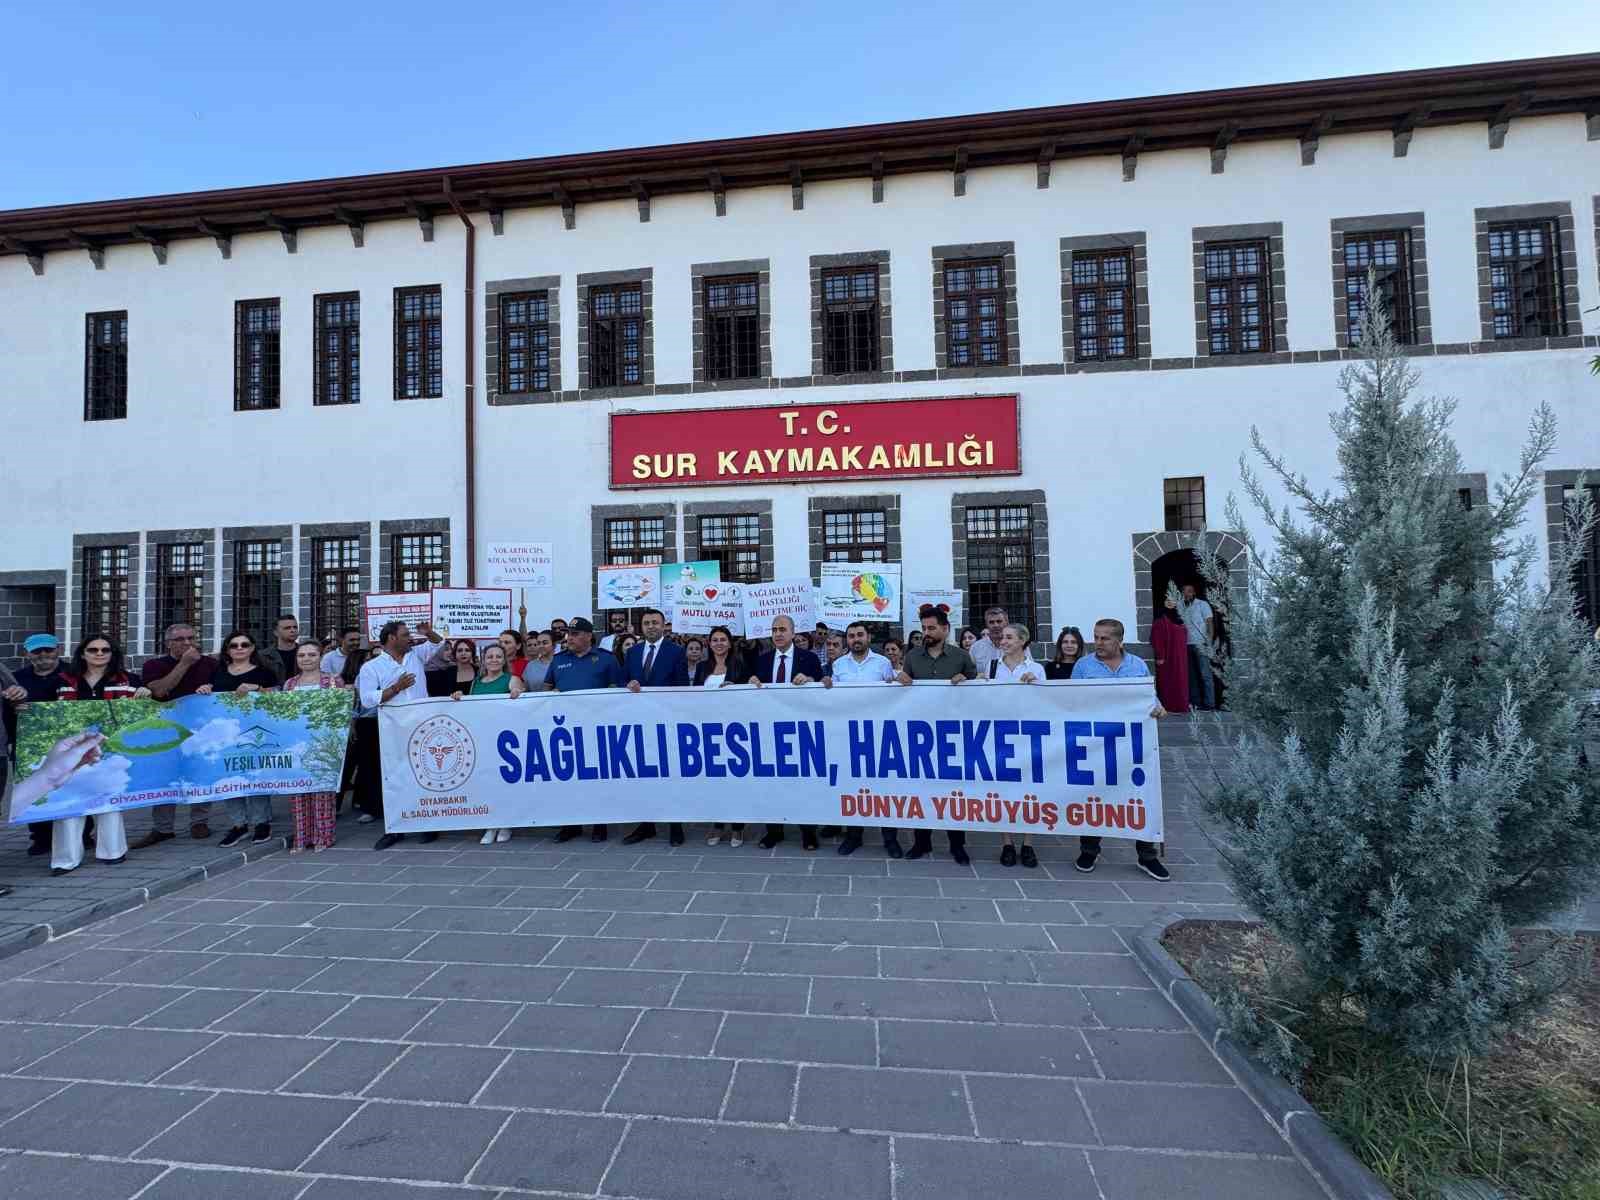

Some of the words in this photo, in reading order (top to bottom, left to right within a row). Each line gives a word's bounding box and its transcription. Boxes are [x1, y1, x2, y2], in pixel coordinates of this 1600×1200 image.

[632, 453, 698, 479] SUR
[718, 434, 994, 475] KAYMAKAMLIĞI
[681, 609, 711, 618] MUTLU
[713, 610, 736, 620] YAŞA
[258, 754, 293, 769] VATAN
[496, 714, 670, 785] SAĞLIKLI
[676, 720, 838, 787] BESLEN,
[848, 719, 1051, 784] HAREKET
[1063, 720, 1146, 787] ET!
[214, 780, 251, 793] EĞİTİM
[253, 775, 313, 790] MÜDÜRLÜĞÜ
[840, 787, 925, 820] DÜNYA
[931, 790, 1059, 831] YÜRÜYÜŞ
[1066, 796, 1147, 830] GÜNÜ
